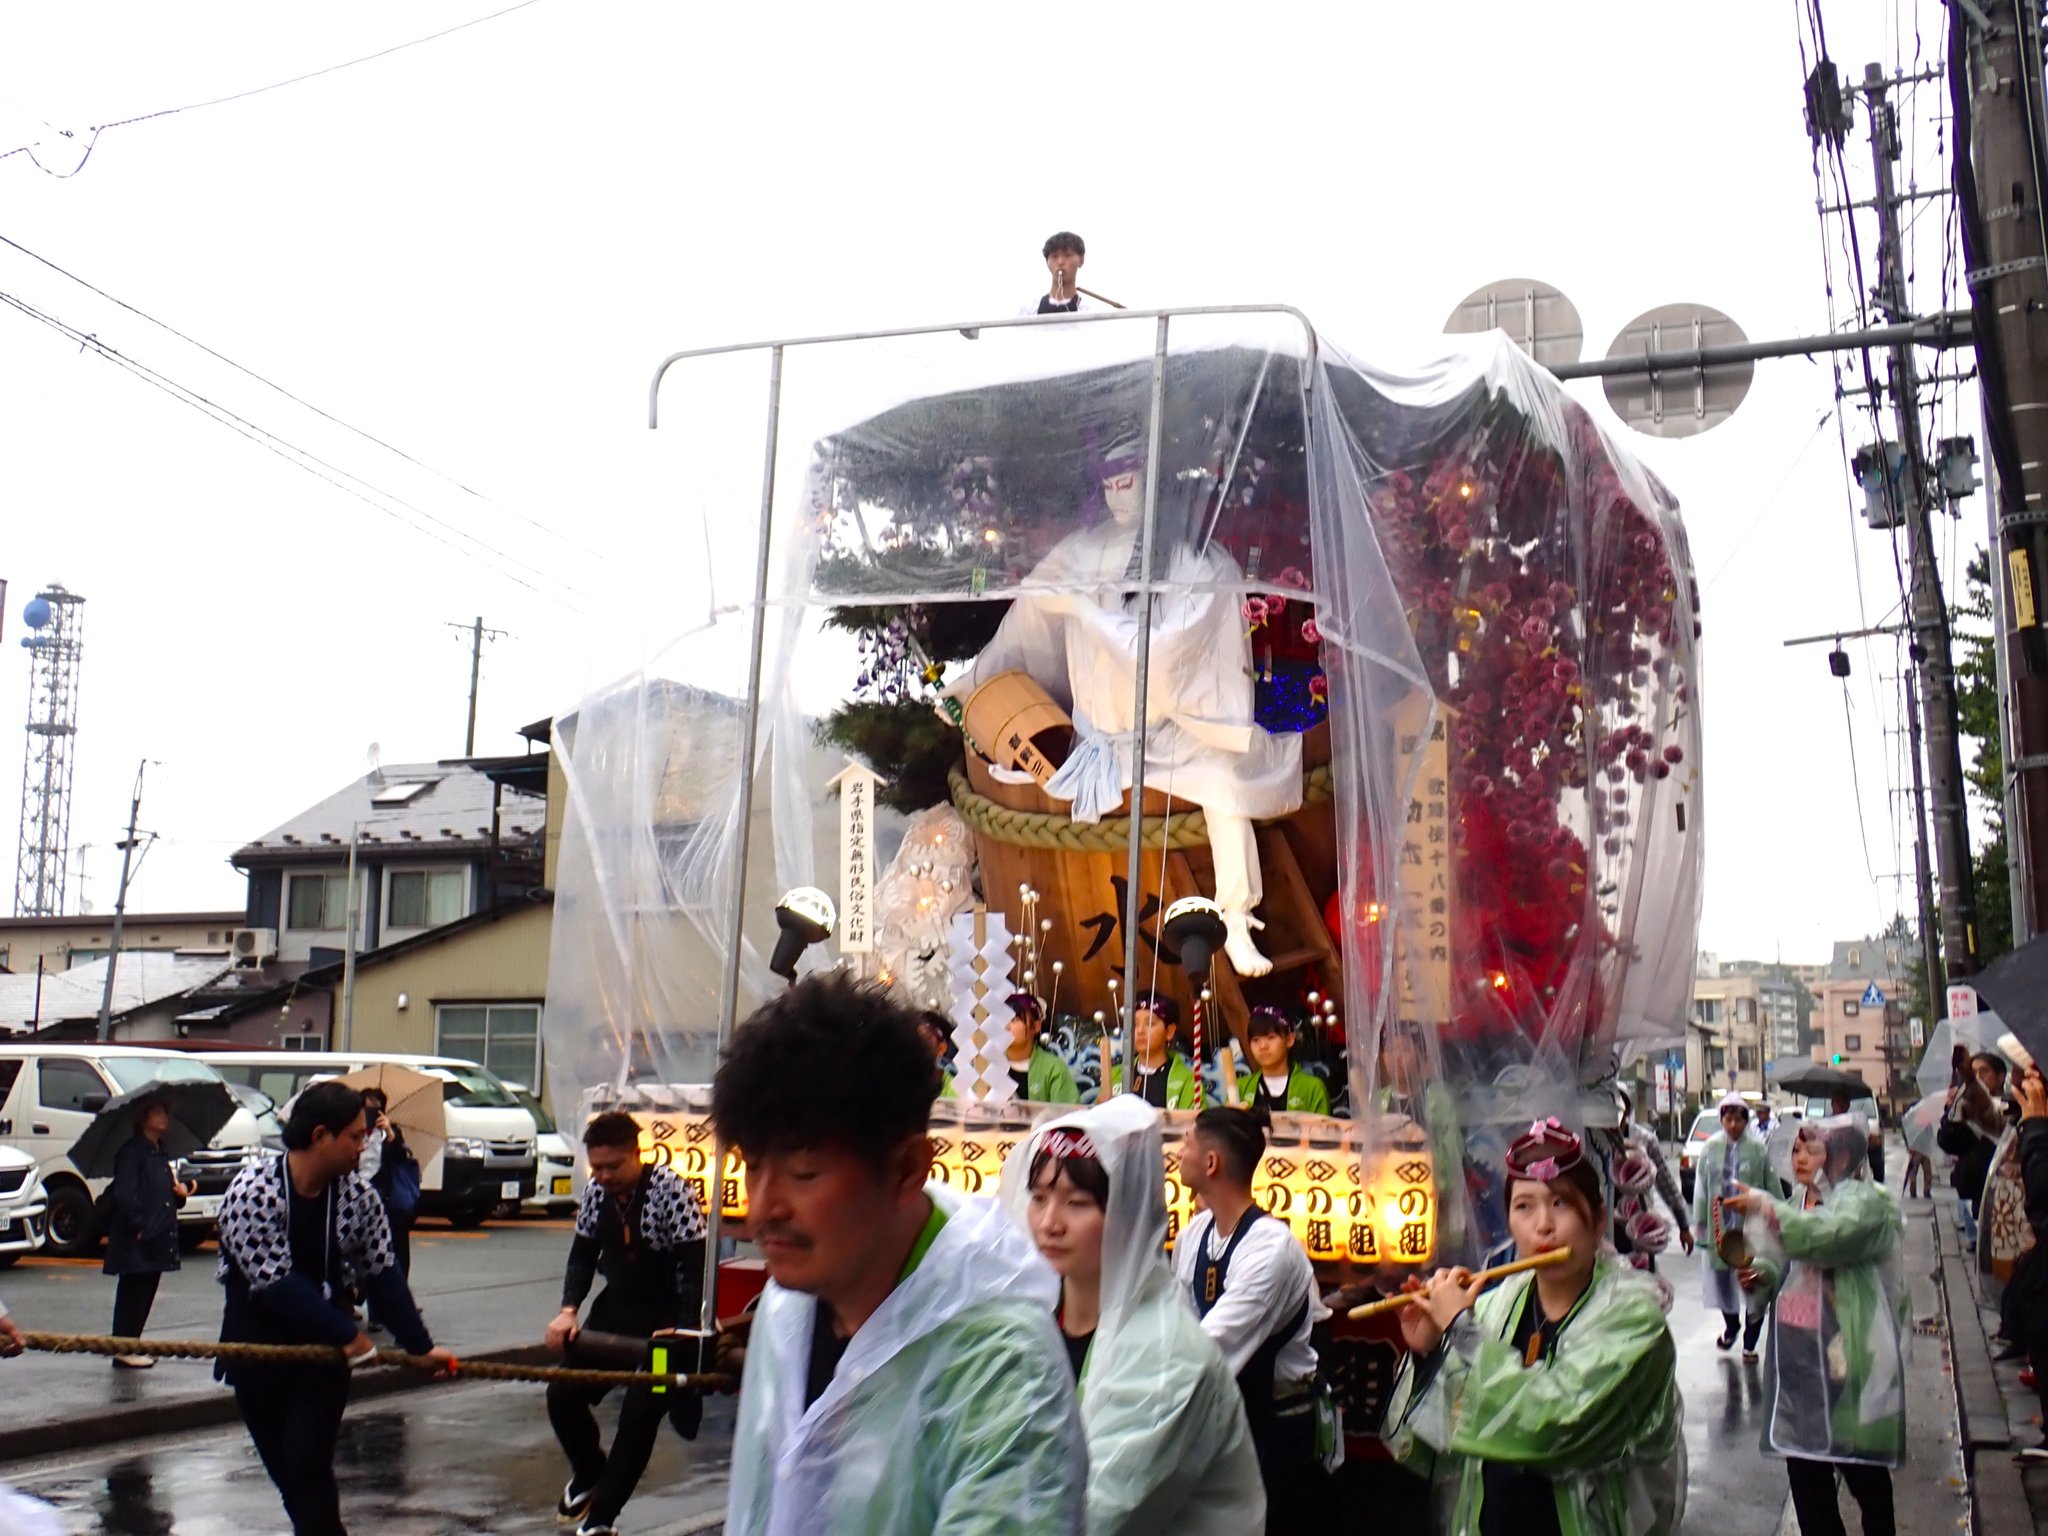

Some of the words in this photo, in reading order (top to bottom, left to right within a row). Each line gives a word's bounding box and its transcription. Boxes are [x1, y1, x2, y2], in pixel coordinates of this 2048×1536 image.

[849, 782, 865, 943] 岩手県指定無形民俗文化財
[1307, 1186, 1333, 1252] の組
[1349, 1190, 1377, 1256] の組
[1400, 1189, 1427, 1255] の組
